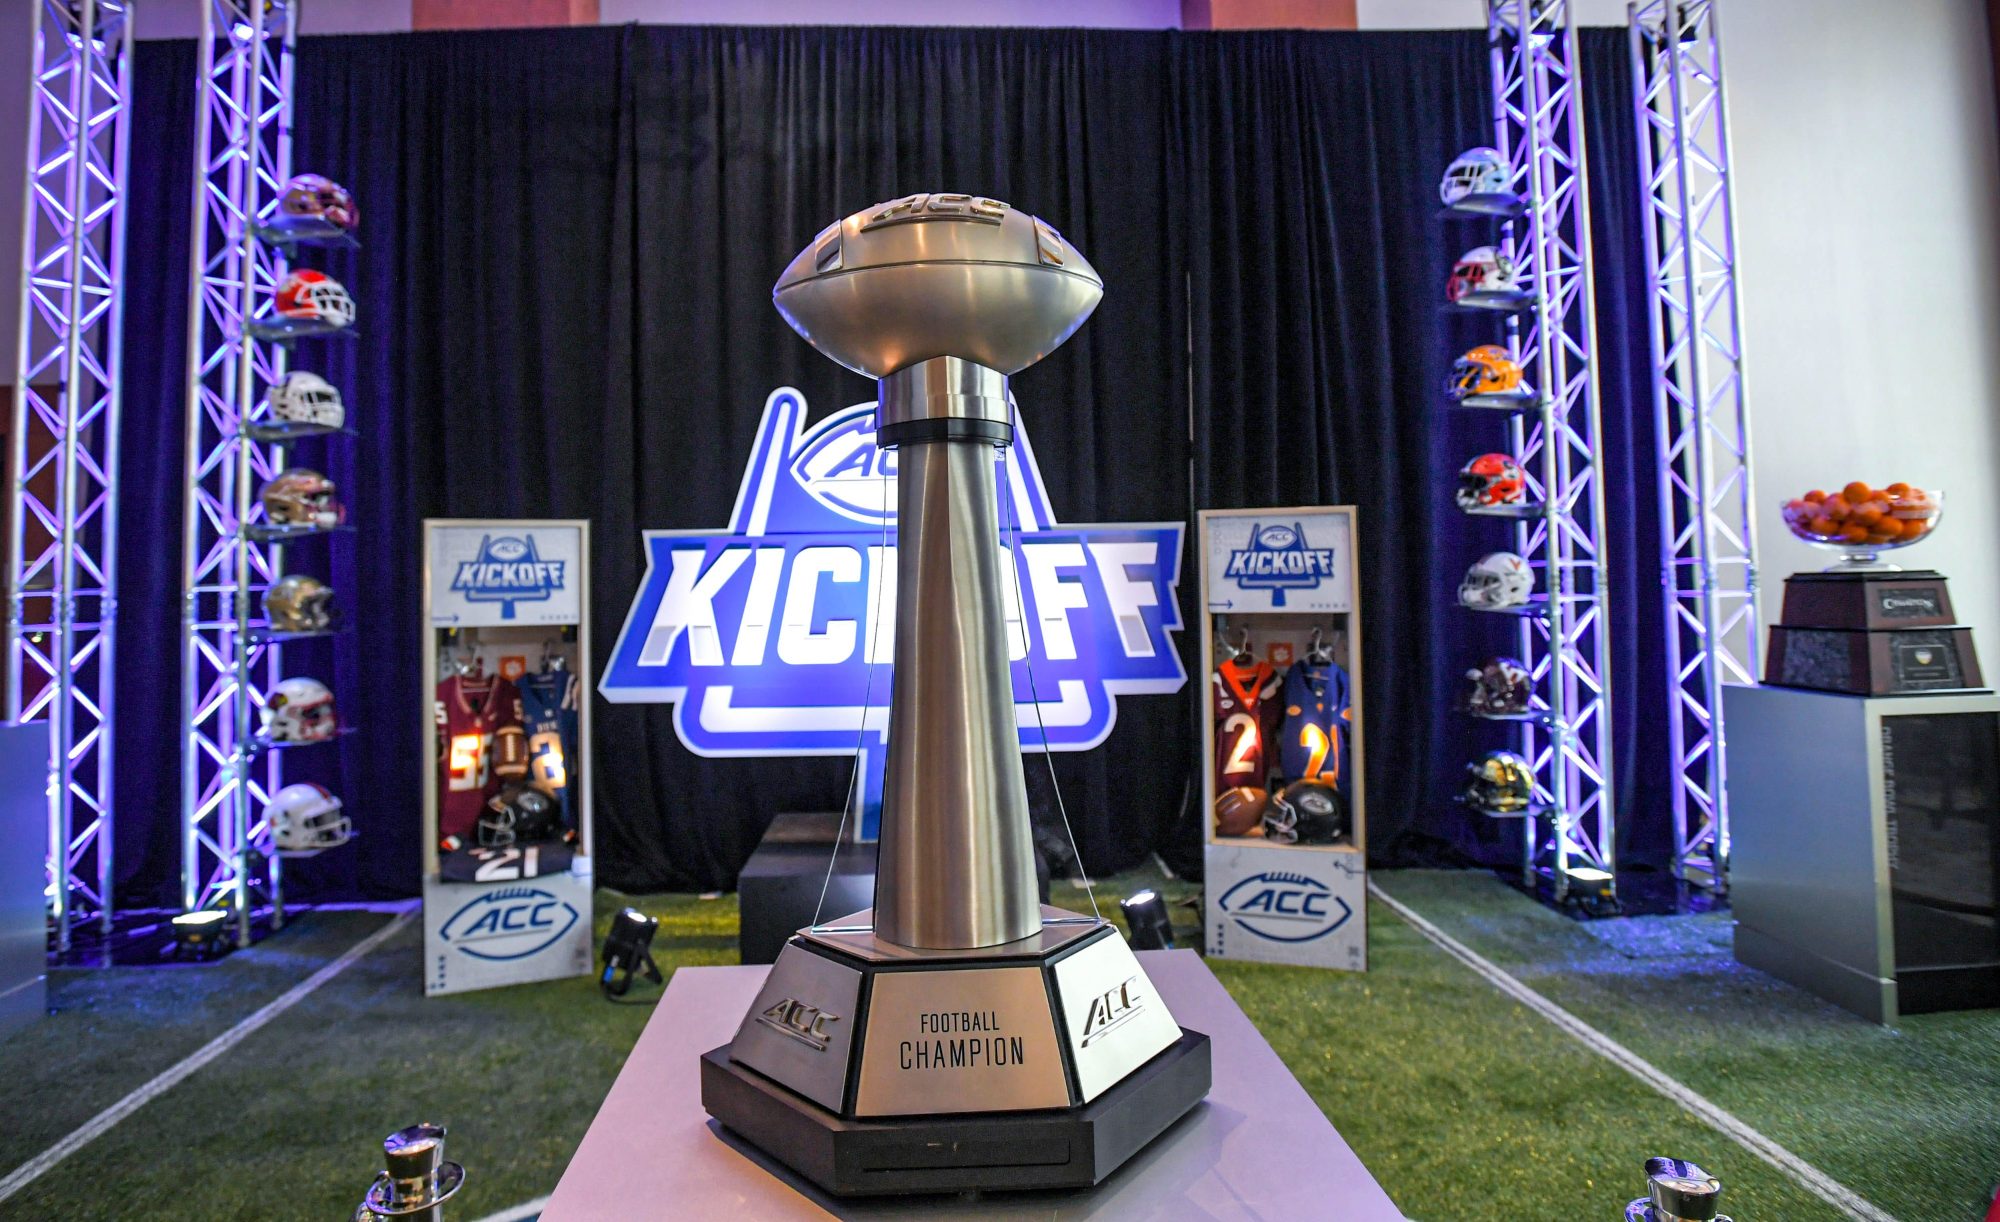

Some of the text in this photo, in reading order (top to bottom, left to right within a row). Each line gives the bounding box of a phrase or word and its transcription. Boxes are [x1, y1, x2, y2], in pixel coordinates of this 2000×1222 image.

[871, 193, 1011, 221] ACC
[824, 442, 897, 477] AC
[455, 562, 564, 587] KICKOFF
[1229, 550, 1332, 575] KICKOFF
[475, 847, 539, 882] 21
[463, 901, 558, 936] ACC
[1239, 889, 1331, 917] ACC
[761, 996, 841, 1043] ACC
[1082, 975, 1142, 1036] ACC
[920, 1011, 1000, 1034] FOOTBALL
[900, 1037, 1024, 1070] CHAMPION
